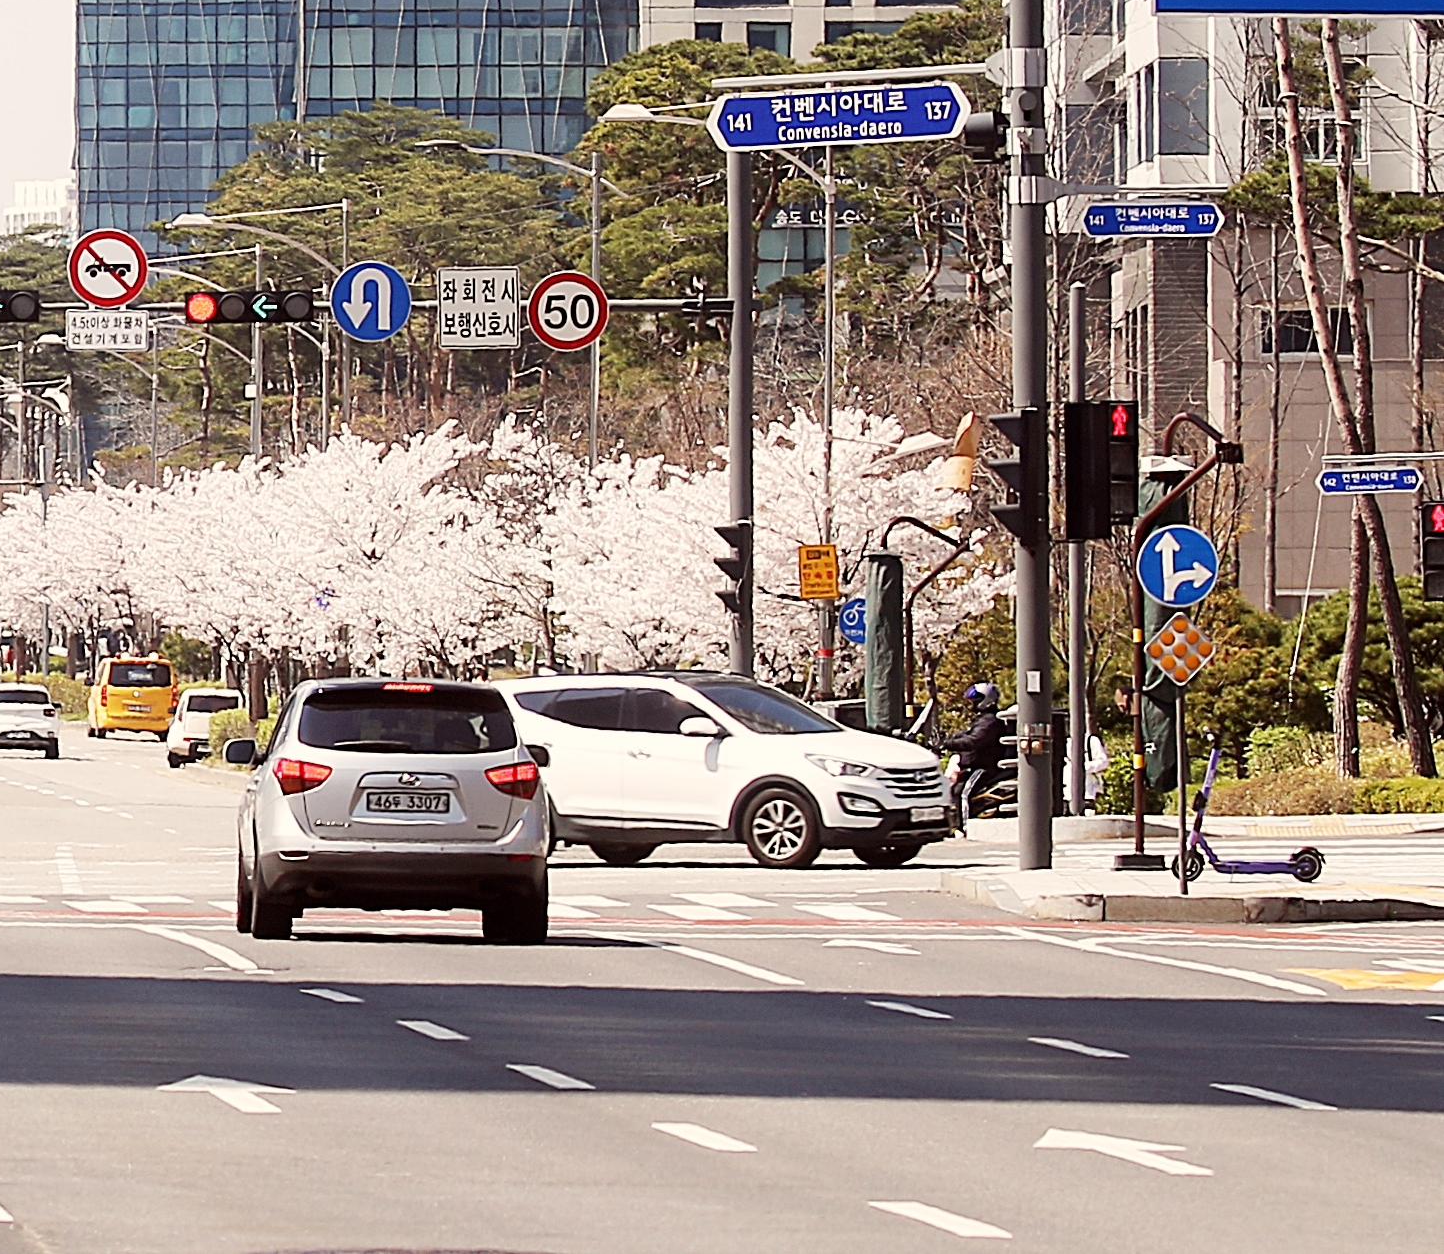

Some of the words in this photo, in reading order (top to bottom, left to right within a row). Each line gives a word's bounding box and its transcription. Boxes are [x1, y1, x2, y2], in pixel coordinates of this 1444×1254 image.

[726, 114, 752, 132] 141
[771, 91, 908, 123] 컨벤시아대로
[925, 102, 951, 121] 137
[778, 121, 902, 142] Convensia-daero
[1089, 215, 1105, 226] 141
[1115, 207, 1190, 222] 컨벤시아대로
[1197, 214, 1215, 225] 137
[543, 294, 594, 330] 50
[443, 312, 516, 338] 보행신호시
[406, 794, 442, 810] 3307
